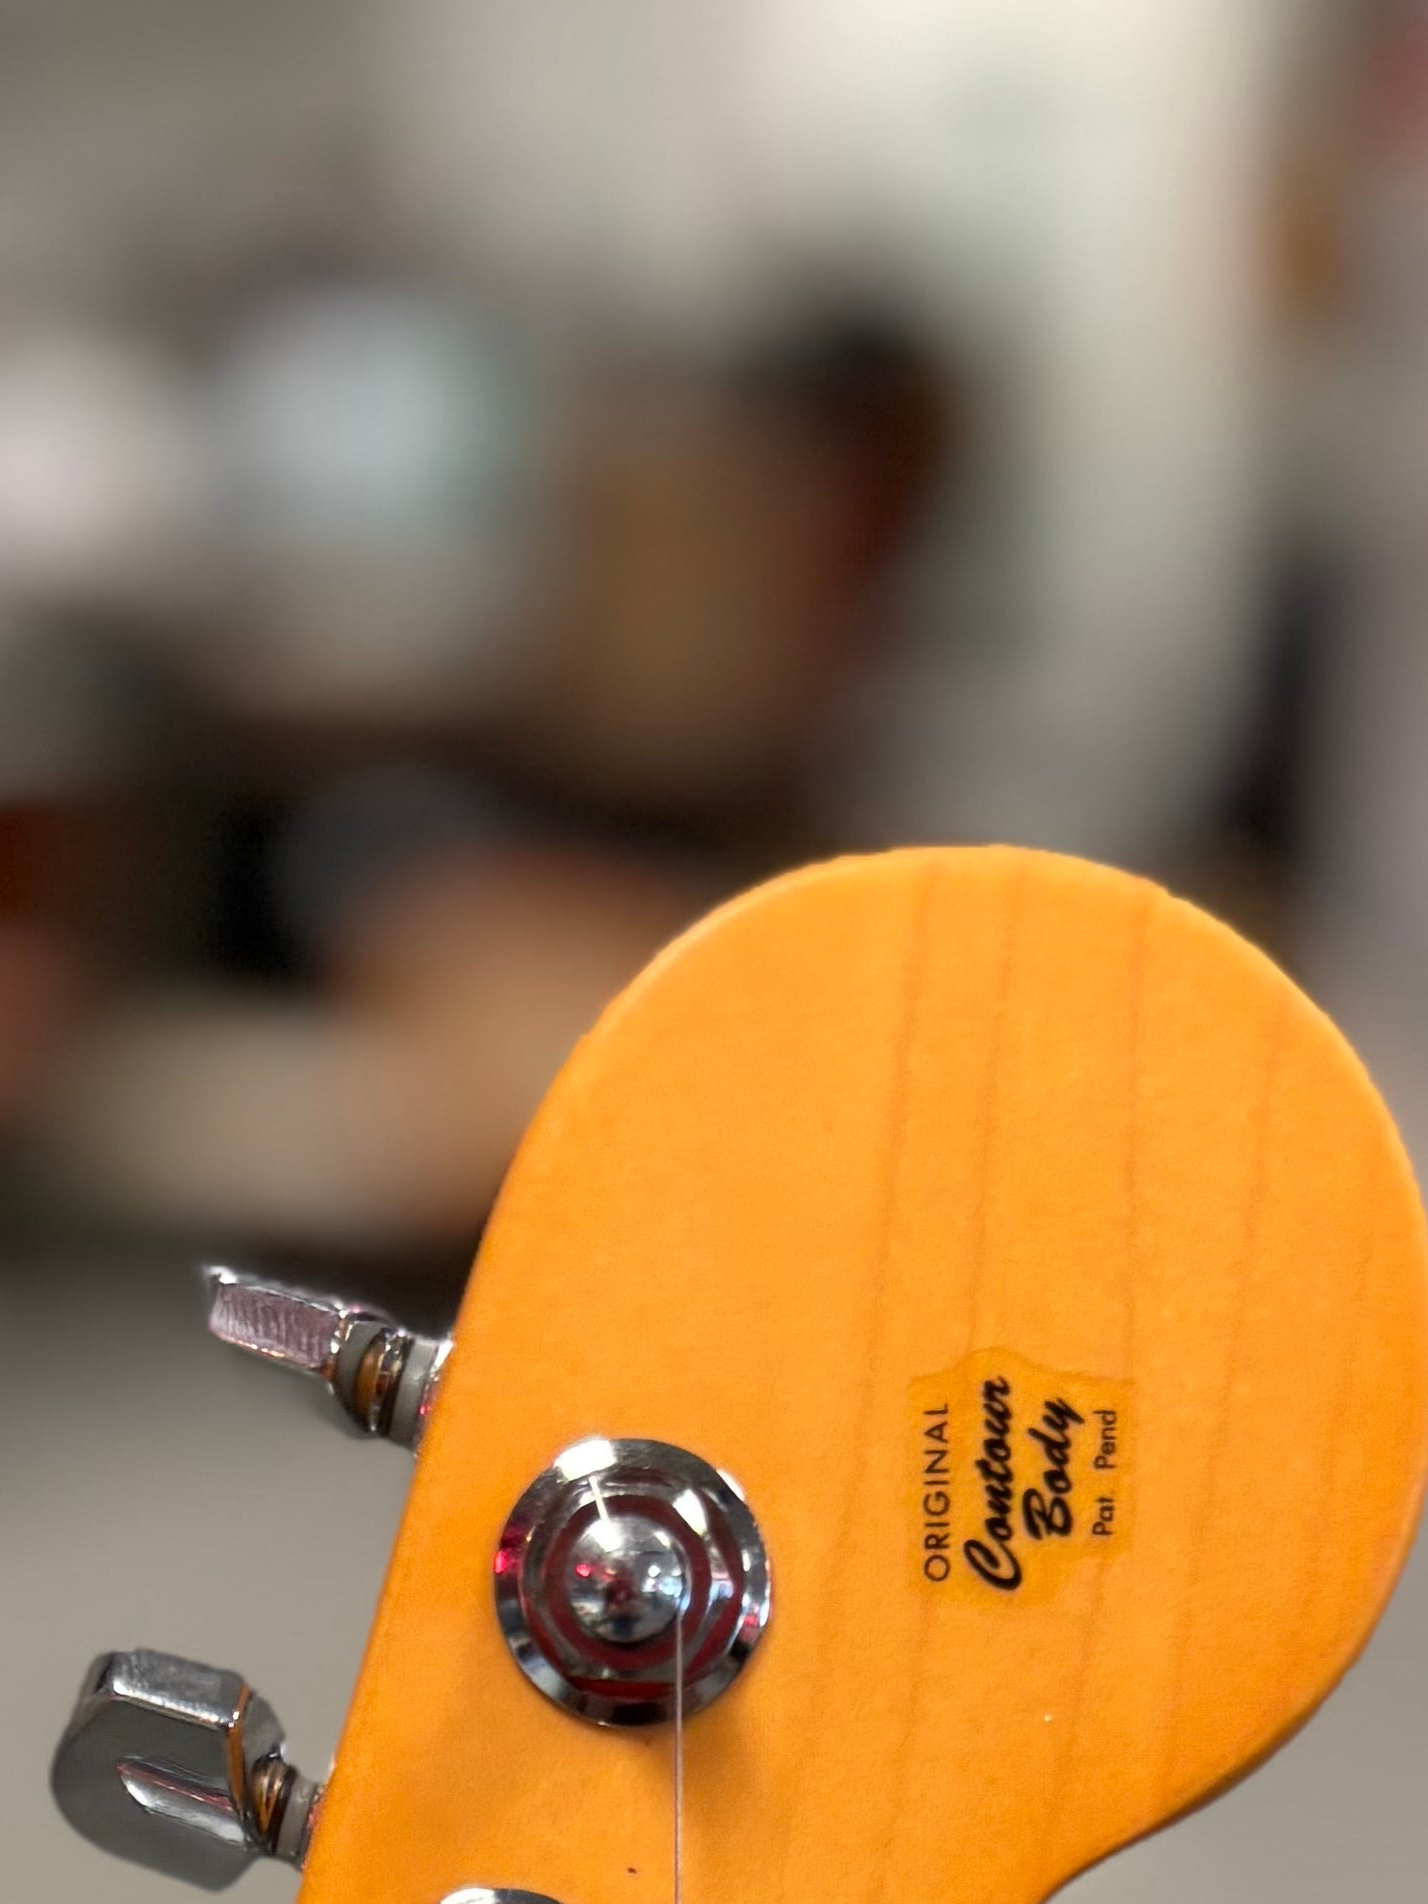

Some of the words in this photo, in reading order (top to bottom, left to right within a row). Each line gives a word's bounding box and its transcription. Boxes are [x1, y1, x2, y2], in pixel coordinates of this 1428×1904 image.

[923, 1403, 950, 1582] ORIGINAL
[963, 1376, 1022, 1591] Contour
[1022, 1398, 1085, 1540] Body
